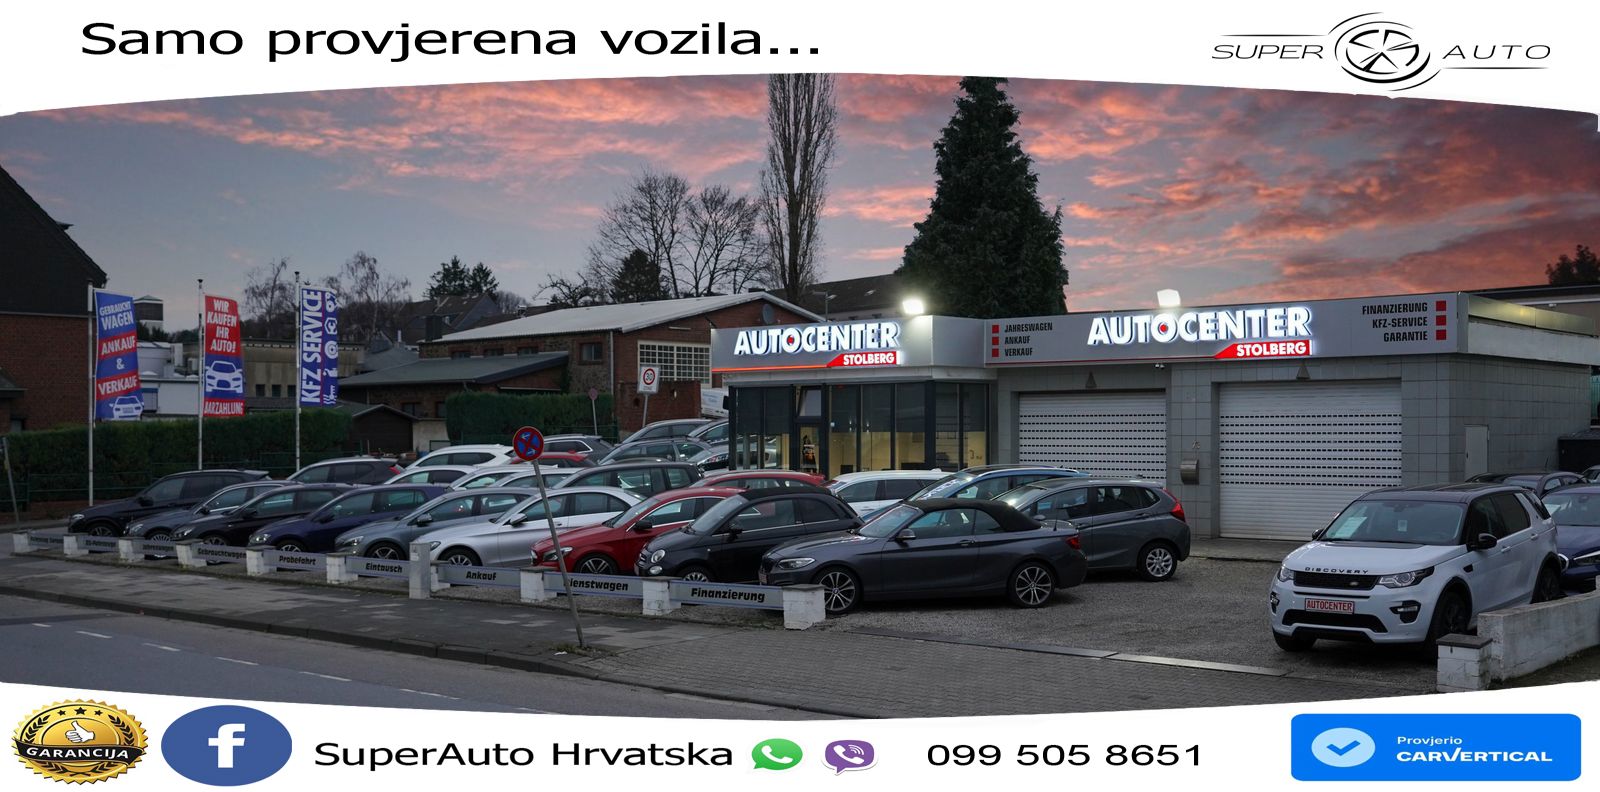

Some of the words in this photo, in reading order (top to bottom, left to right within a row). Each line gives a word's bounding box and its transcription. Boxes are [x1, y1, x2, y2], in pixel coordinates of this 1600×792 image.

[213, 299, 229, 312] WIR
[1362, 302, 1428, 315] FINANZIERUNG
[101, 310, 134, 331] WAGEN
[207, 312, 237, 327] KAUFEN
[302, 289, 322, 363] SERVICE
[1087, 307, 1312, 346] AUTOCENTER
[1372, 316, 1428, 329] KFZ-SERVICE
[216, 327, 230, 340] IHR
[1004, 322, 1053, 333] JAHRESWAGEN
[734, 322, 900, 355] AUTOCENTER
[1004, 335, 1031, 345] ANKAUF
[1383, 331, 1428, 342] GARANTIE
[101, 334, 136, 357] ANKAUF
[210, 338, 237, 353] AUTO!
[1004, 347, 1033, 357] VERKAUF
[1236, 342, 1307, 357] STOLBERG
[843, 352, 895, 366] STOLBERG
[98, 374, 138, 396] VERKAUF
[302, 363, 321, 403] KFZ
[365, 562, 403, 574] Eintausch
[465, 570, 497, 581] Ankauf
[564, 578, 629, 592] ienstwagen
[691, 587, 766, 604] Finanzierung
[1306, 600, 1353, 612] AUTOCENTER
